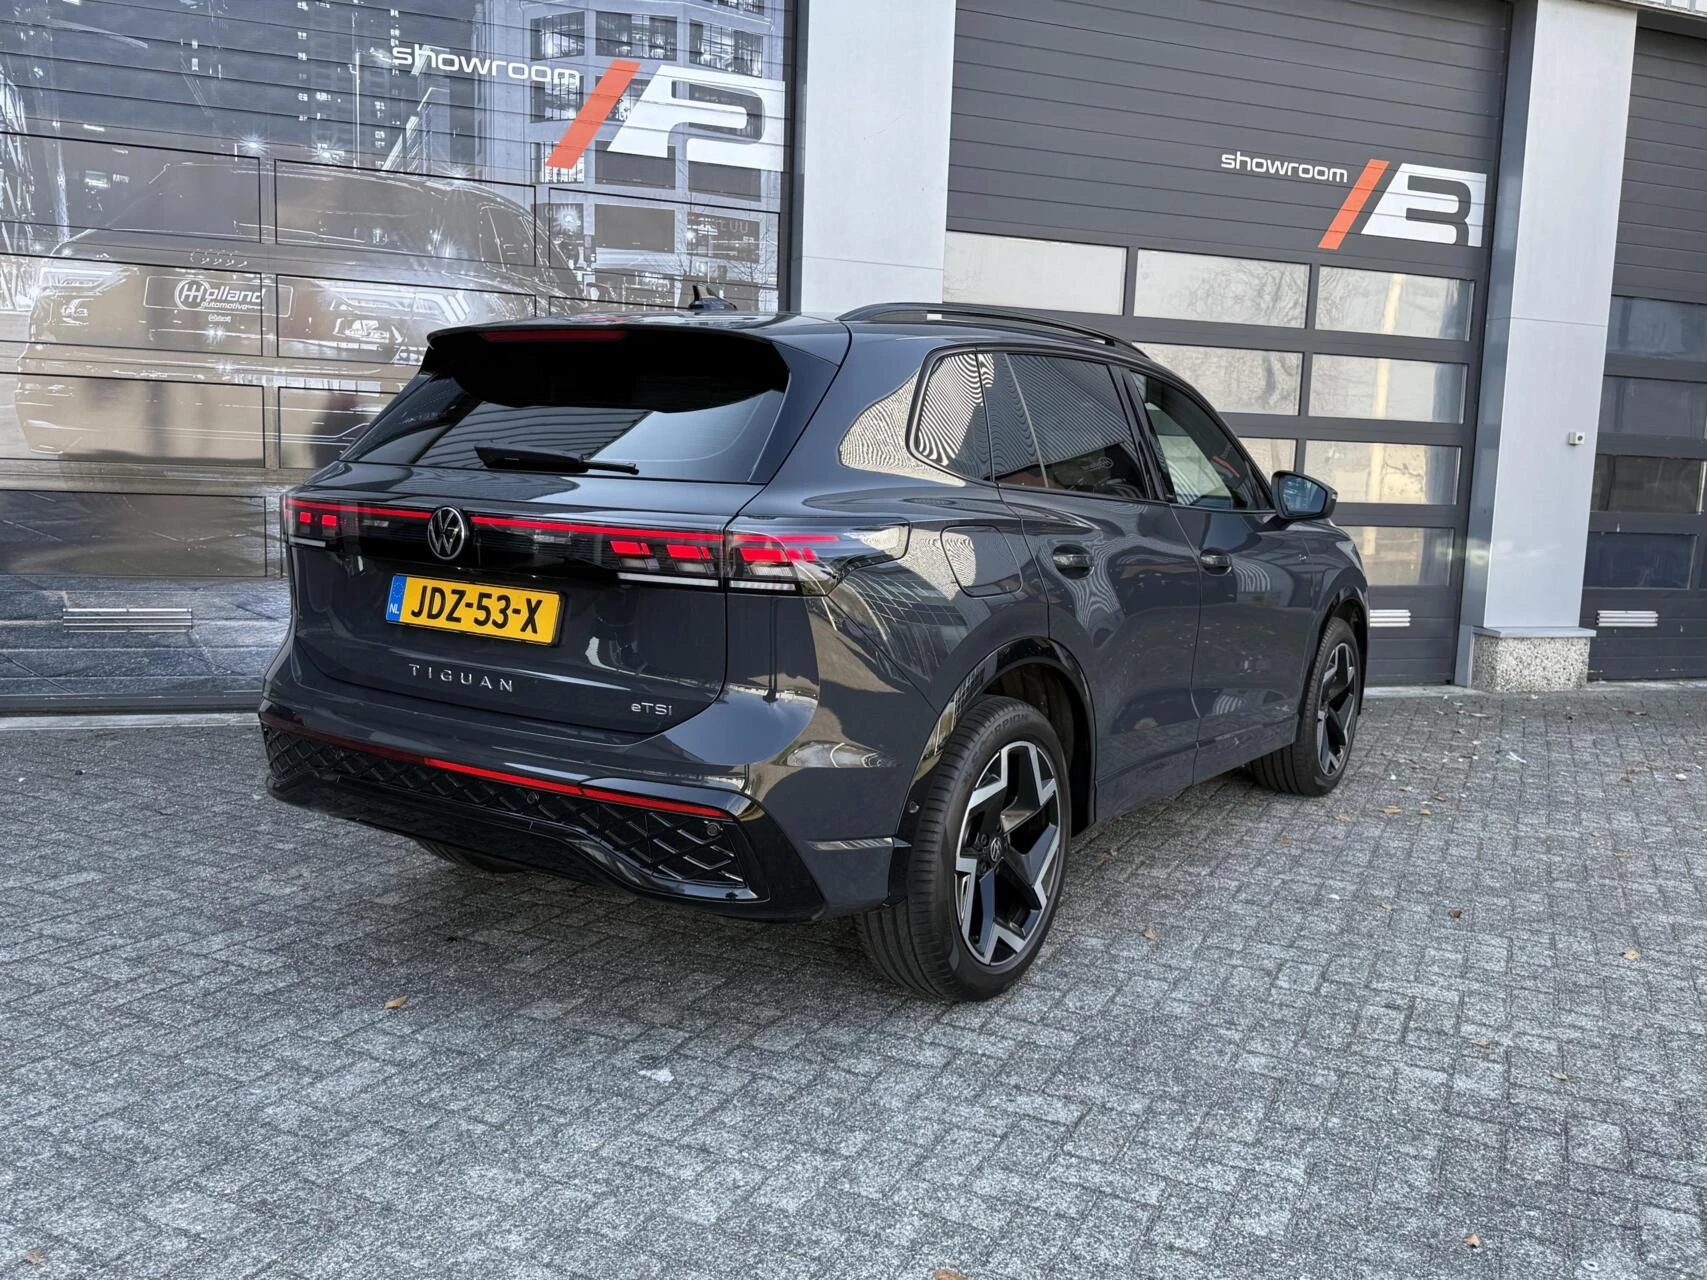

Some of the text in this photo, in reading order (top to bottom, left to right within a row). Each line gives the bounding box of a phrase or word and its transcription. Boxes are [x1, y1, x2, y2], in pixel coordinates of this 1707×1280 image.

[392, 43, 580, 90] showroom
[1221, 151, 1348, 183] showroom
[389, 603, 400, 614] NL
[411, 585, 543, 634] JDZ-53-X
[408, 663, 512, 692] TIGUAN
